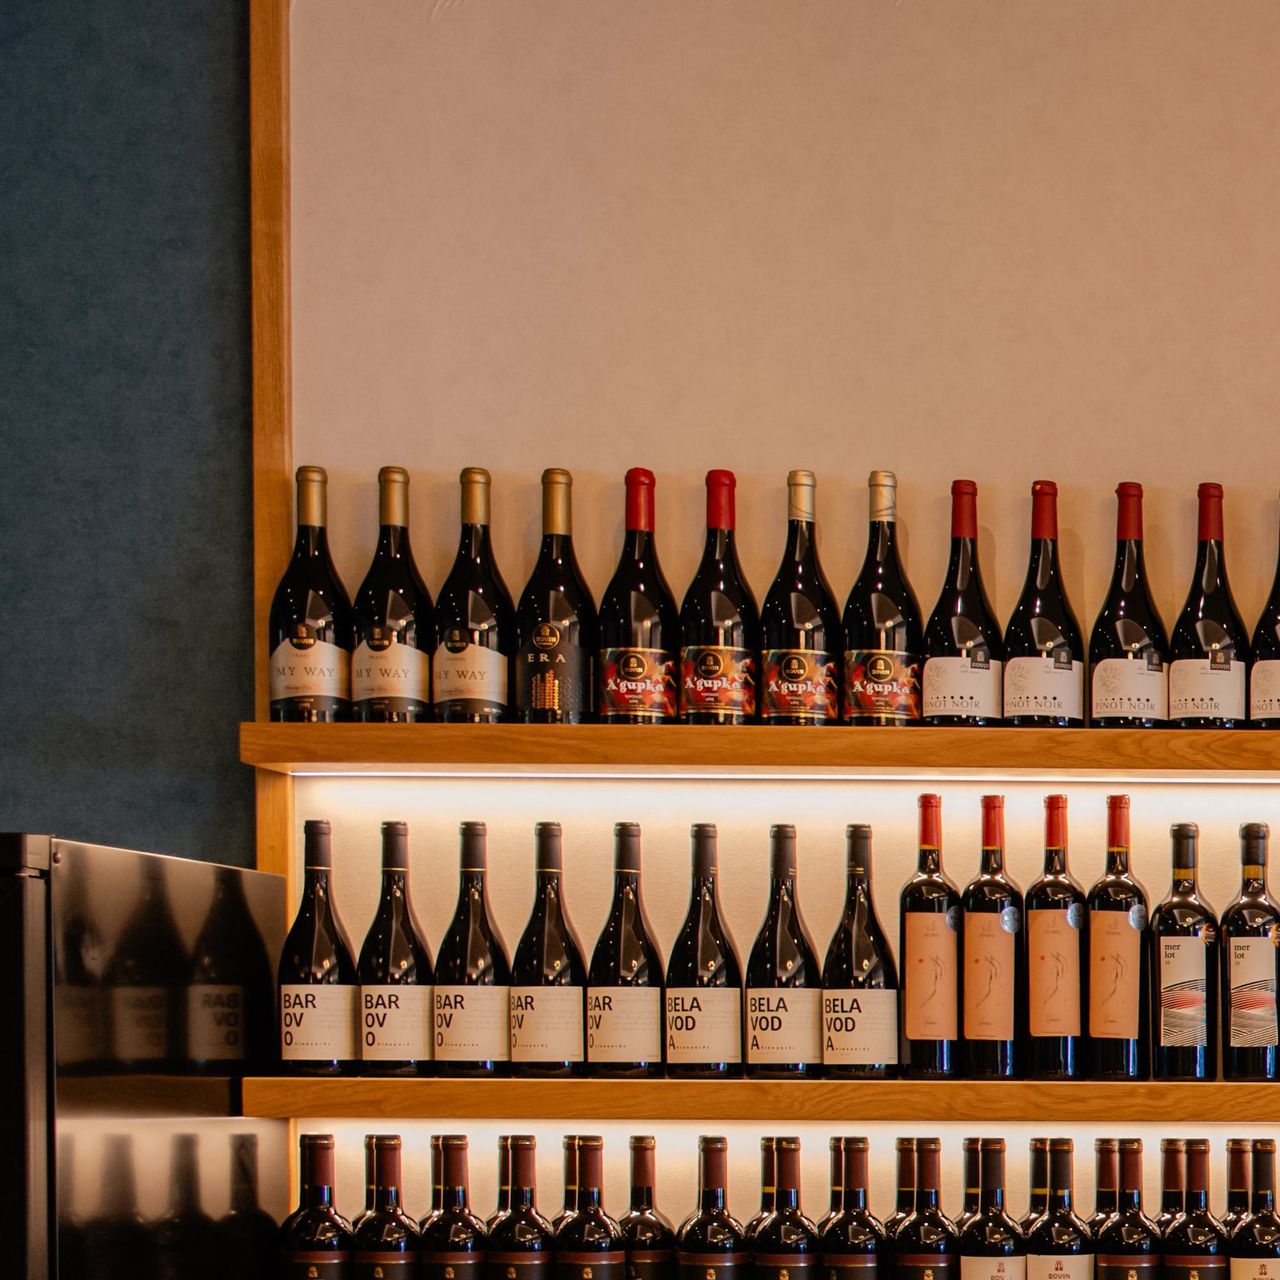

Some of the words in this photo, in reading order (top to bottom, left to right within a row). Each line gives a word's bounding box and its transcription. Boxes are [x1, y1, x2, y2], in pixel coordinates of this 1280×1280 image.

[528, 653, 567, 663] ERA
[276, 666, 296, 677] MY
[304, 666, 335, 678] WAY
[355, 667, 373, 679] MY
[379, 667, 411, 679] WAY
[456, 670, 486, 681] WAY
[952, 700, 980, 709] NOIR
[1035, 700, 1063, 709] NOIR
[1129, 702, 1156, 711] NOIR
[1193, 701, 1220, 710] NOIR
[1164, 951, 1175, 959] lot
[284, 993, 317, 1009] BAR
[364, 993, 400, 1009] BAR
[436, 994, 465, 1010] BAR
[668, 997, 702, 1012] BELA
[750, 997, 788, 1012] BELA
[825, 998, 862, 1014] BELA
[284, 1012, 304, 1027] OV
[365, 1013, 388, 1027] OV
[436, 1013, 453, 1028] OV
[668, 1016, 696, 1031] VOD
[750, 1016, 782, 1031] VOD
[825, 1017, 856, 1032] VOD
[284, 1031, 293, 1046] O
[366, 1031, 375, 1046] O
[669, 1034, 675, 1050] A
[751, 1035, 759, 1050] A
[826, 1036, 834, 1051] A
